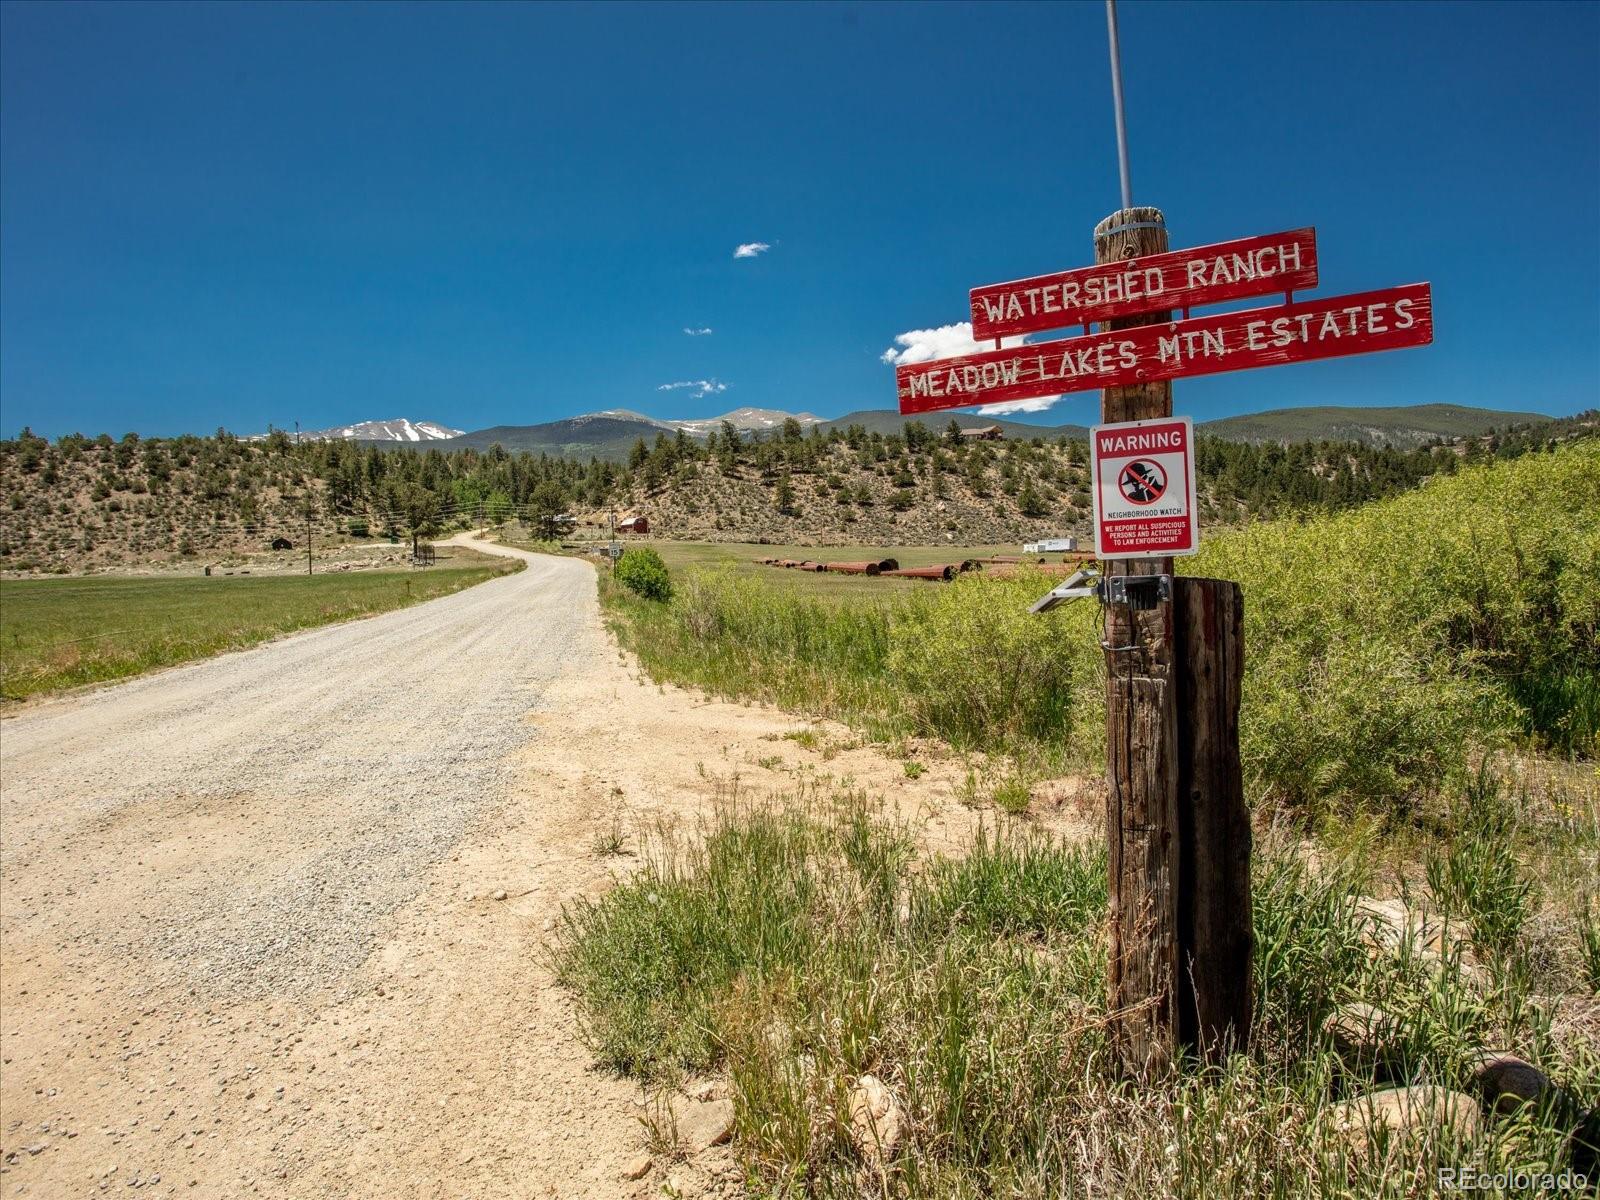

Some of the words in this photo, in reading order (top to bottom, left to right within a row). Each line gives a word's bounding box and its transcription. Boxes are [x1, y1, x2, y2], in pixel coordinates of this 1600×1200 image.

[983, 267, 1164, 322] WATERSHED
[1187, 242, 1301, 289] RANCH
[909, 357, 1021, 398] MEADOW
[1038, 340, 1138, 380] LAKES
[1247, 299, 1414, 351] ESTATES
[1100, 431, 1182, 453] WARNING
[1107, 509, 1158, 519] NEIGHBORHOOD
[1160, 507, 1182, 516] WATCH
[1105, 525, 1114, 533] WE
[1115, 524, 1137, 532] REPORT
[1138, 523, 1149, 531] ALL
[1150, 521, 1186, 530] SUSPICIOUS
[1109, 531, 1137, 539] PERSONS
[1137, 530, 1150, 538] AND
[1151, 528, 1182, 537] ACTIVITIES
[1122, 538, 1134, 546] LAW
[1135, 536, 1178, 545] ENFORCEMENT
